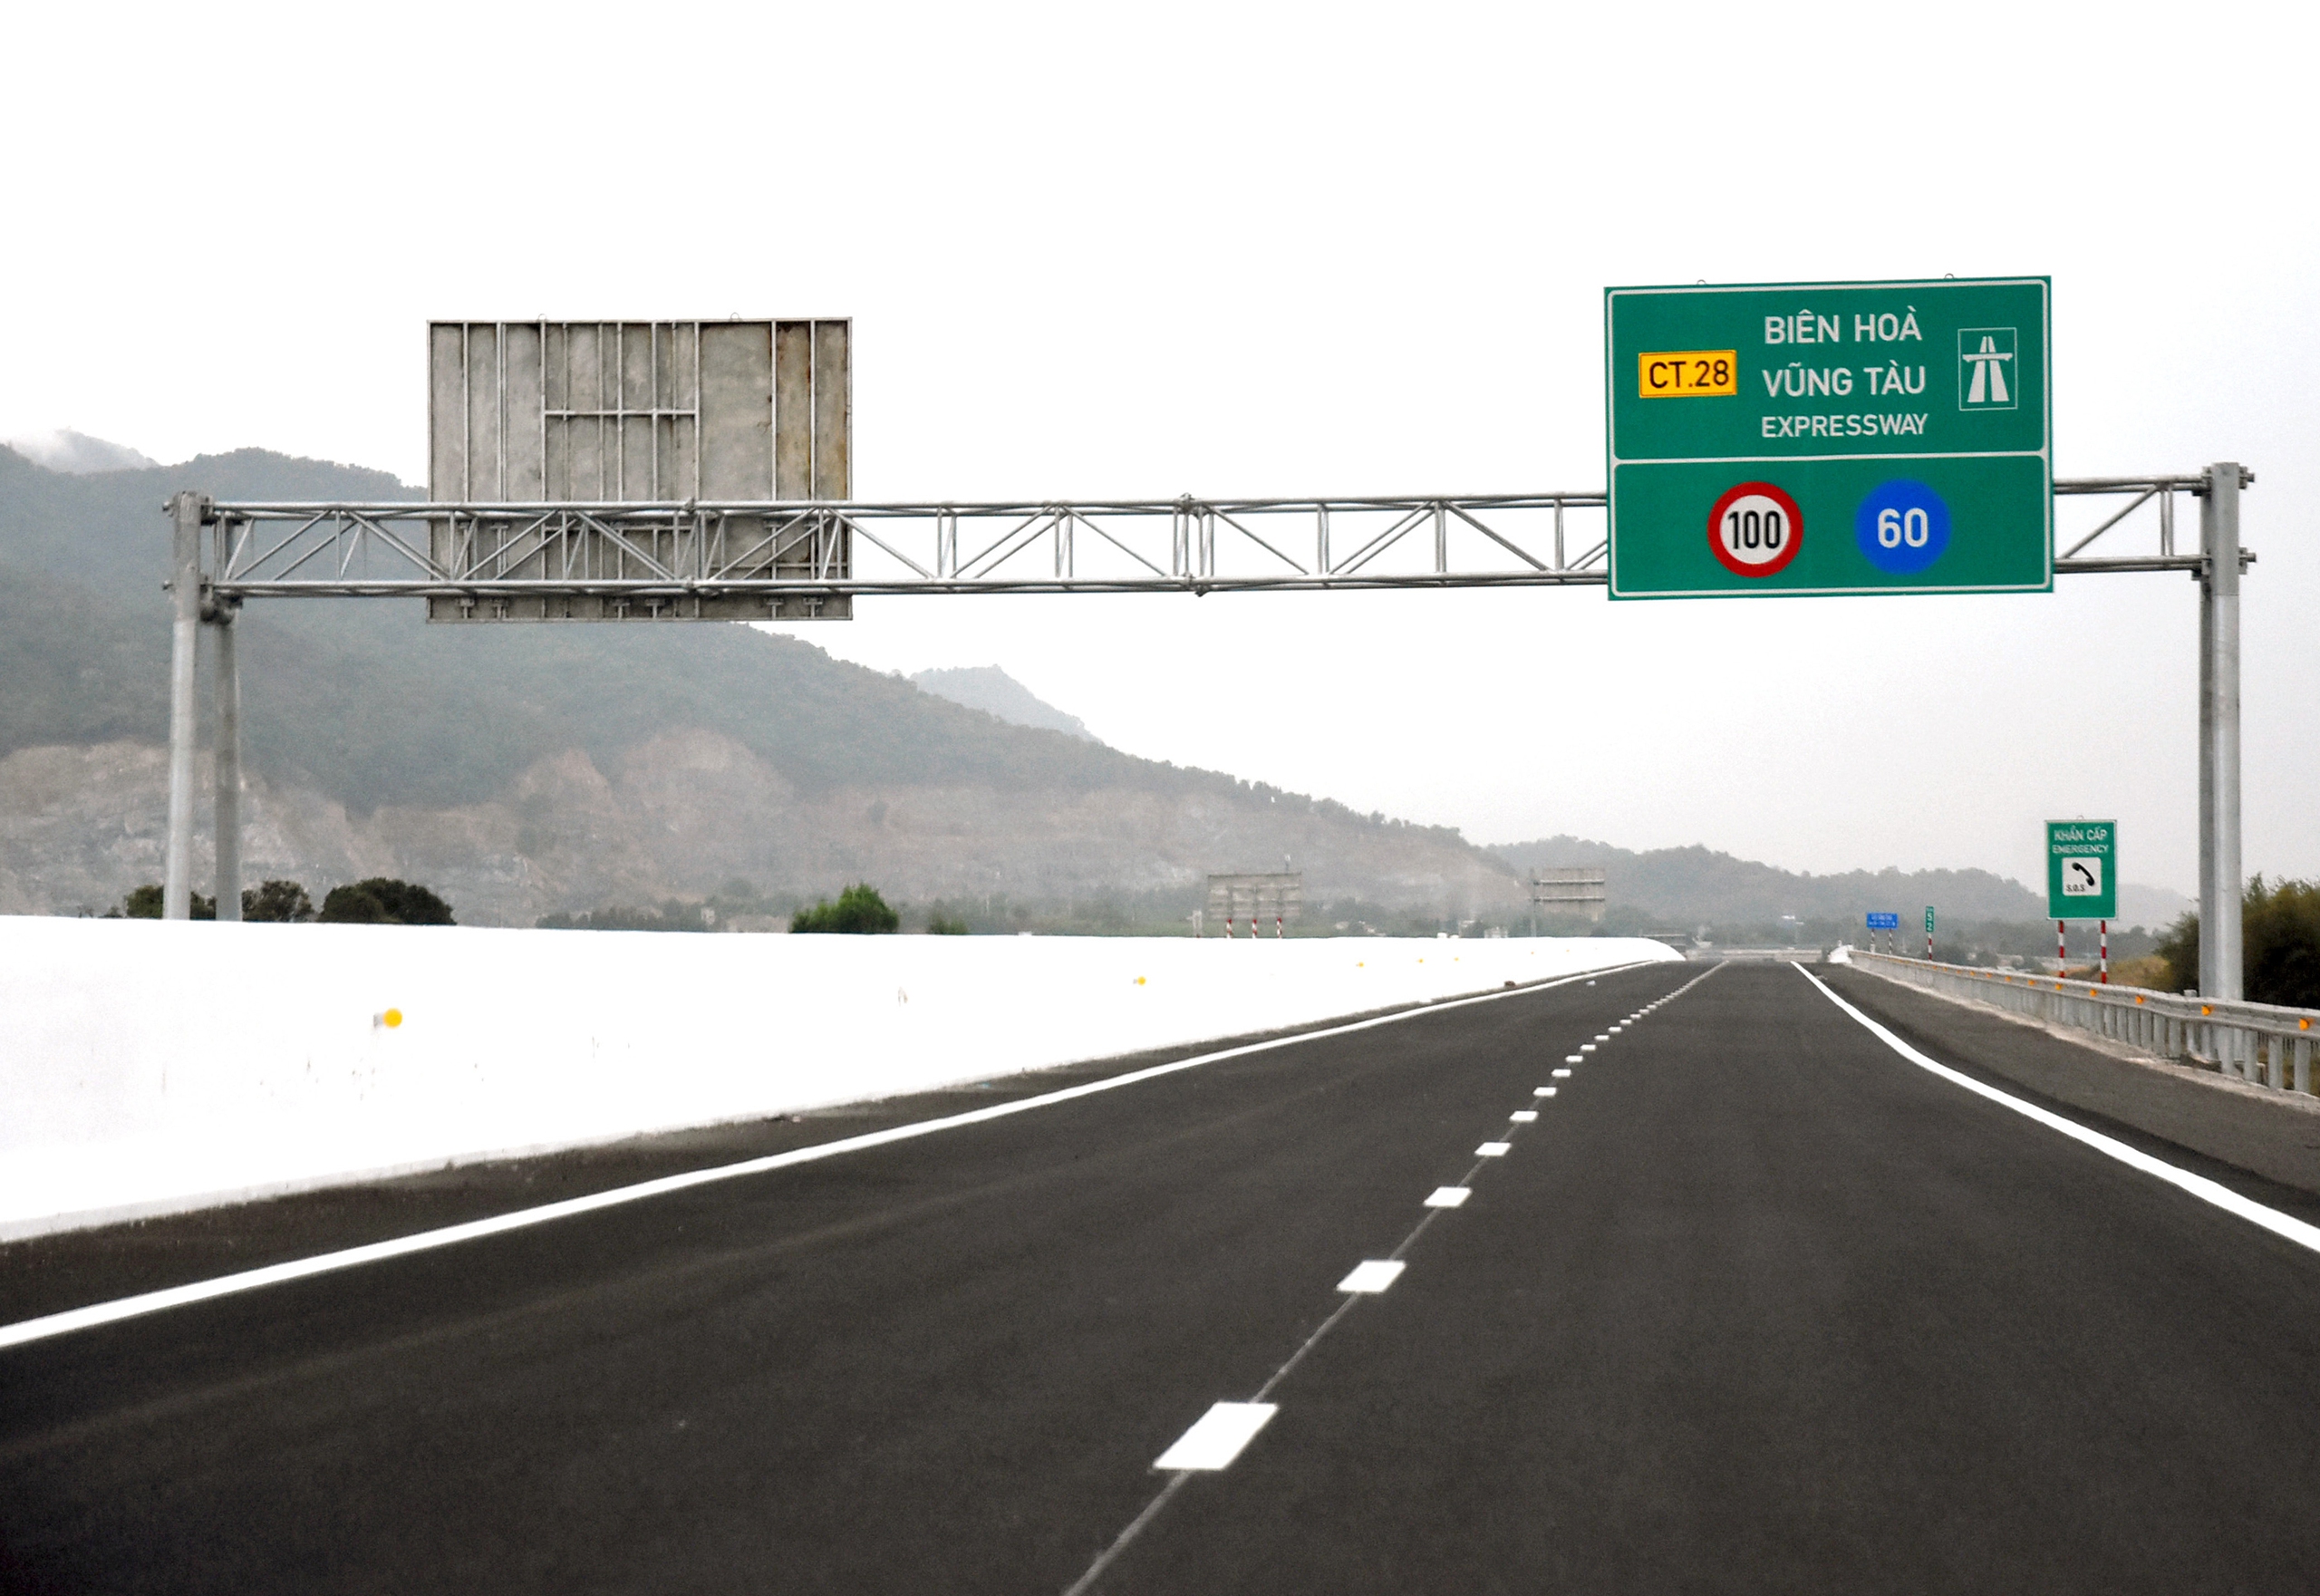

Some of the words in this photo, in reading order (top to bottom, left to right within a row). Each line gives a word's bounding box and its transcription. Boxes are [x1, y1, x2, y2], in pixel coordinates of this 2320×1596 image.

[1764, 309, 1840, 344] BIÊN
[1854, 305, 1922, 343] HOÀ
[1648, 360, 1729, 390] CT.28
[1762, 362, 1853, 398] VŨNG
[1863, 359, 1926, 395] TÀU
[1762, 413, 1928, 438] EXPRESSWAY
[1727, 510, 1781, 549] 100
[1878, 508, 1928, 548] 60
[2053, 844, 2109, 854] EMERGENCY
